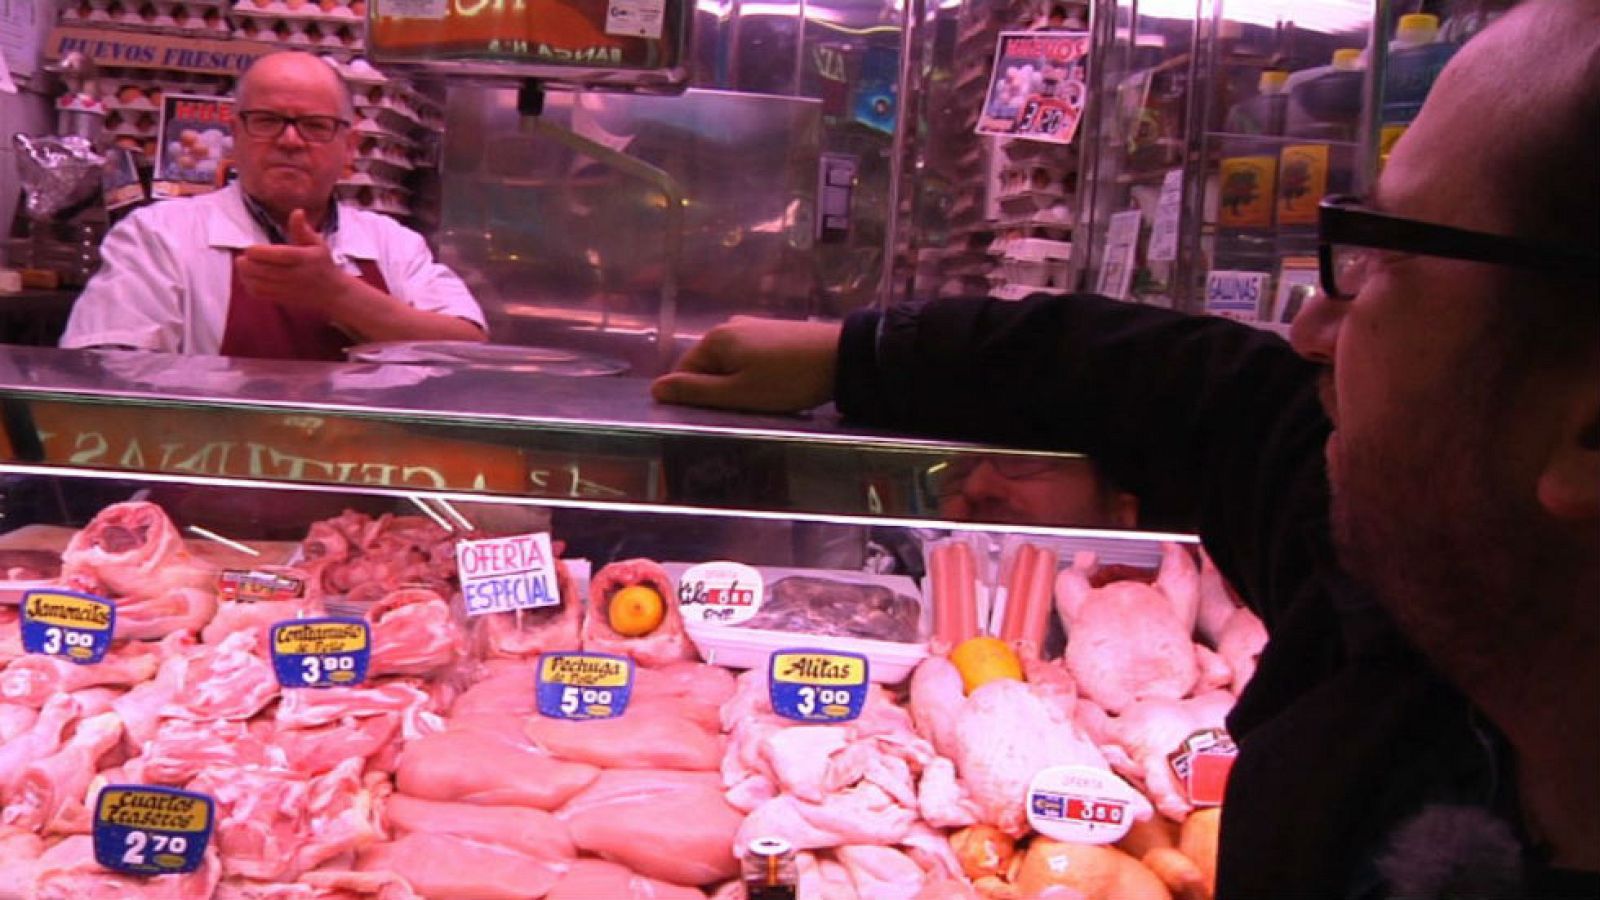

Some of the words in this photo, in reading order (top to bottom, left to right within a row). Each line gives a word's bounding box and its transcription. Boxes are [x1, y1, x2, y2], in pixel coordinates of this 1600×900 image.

[163, 47, 257, 71] FRESCO
[176, 101, 232, 122] HUE
[461, 538, 546, 573] OFERTA
[464, 573, 556, 611] ESPECIAL
[783, 657, 850, 679] Alitas
